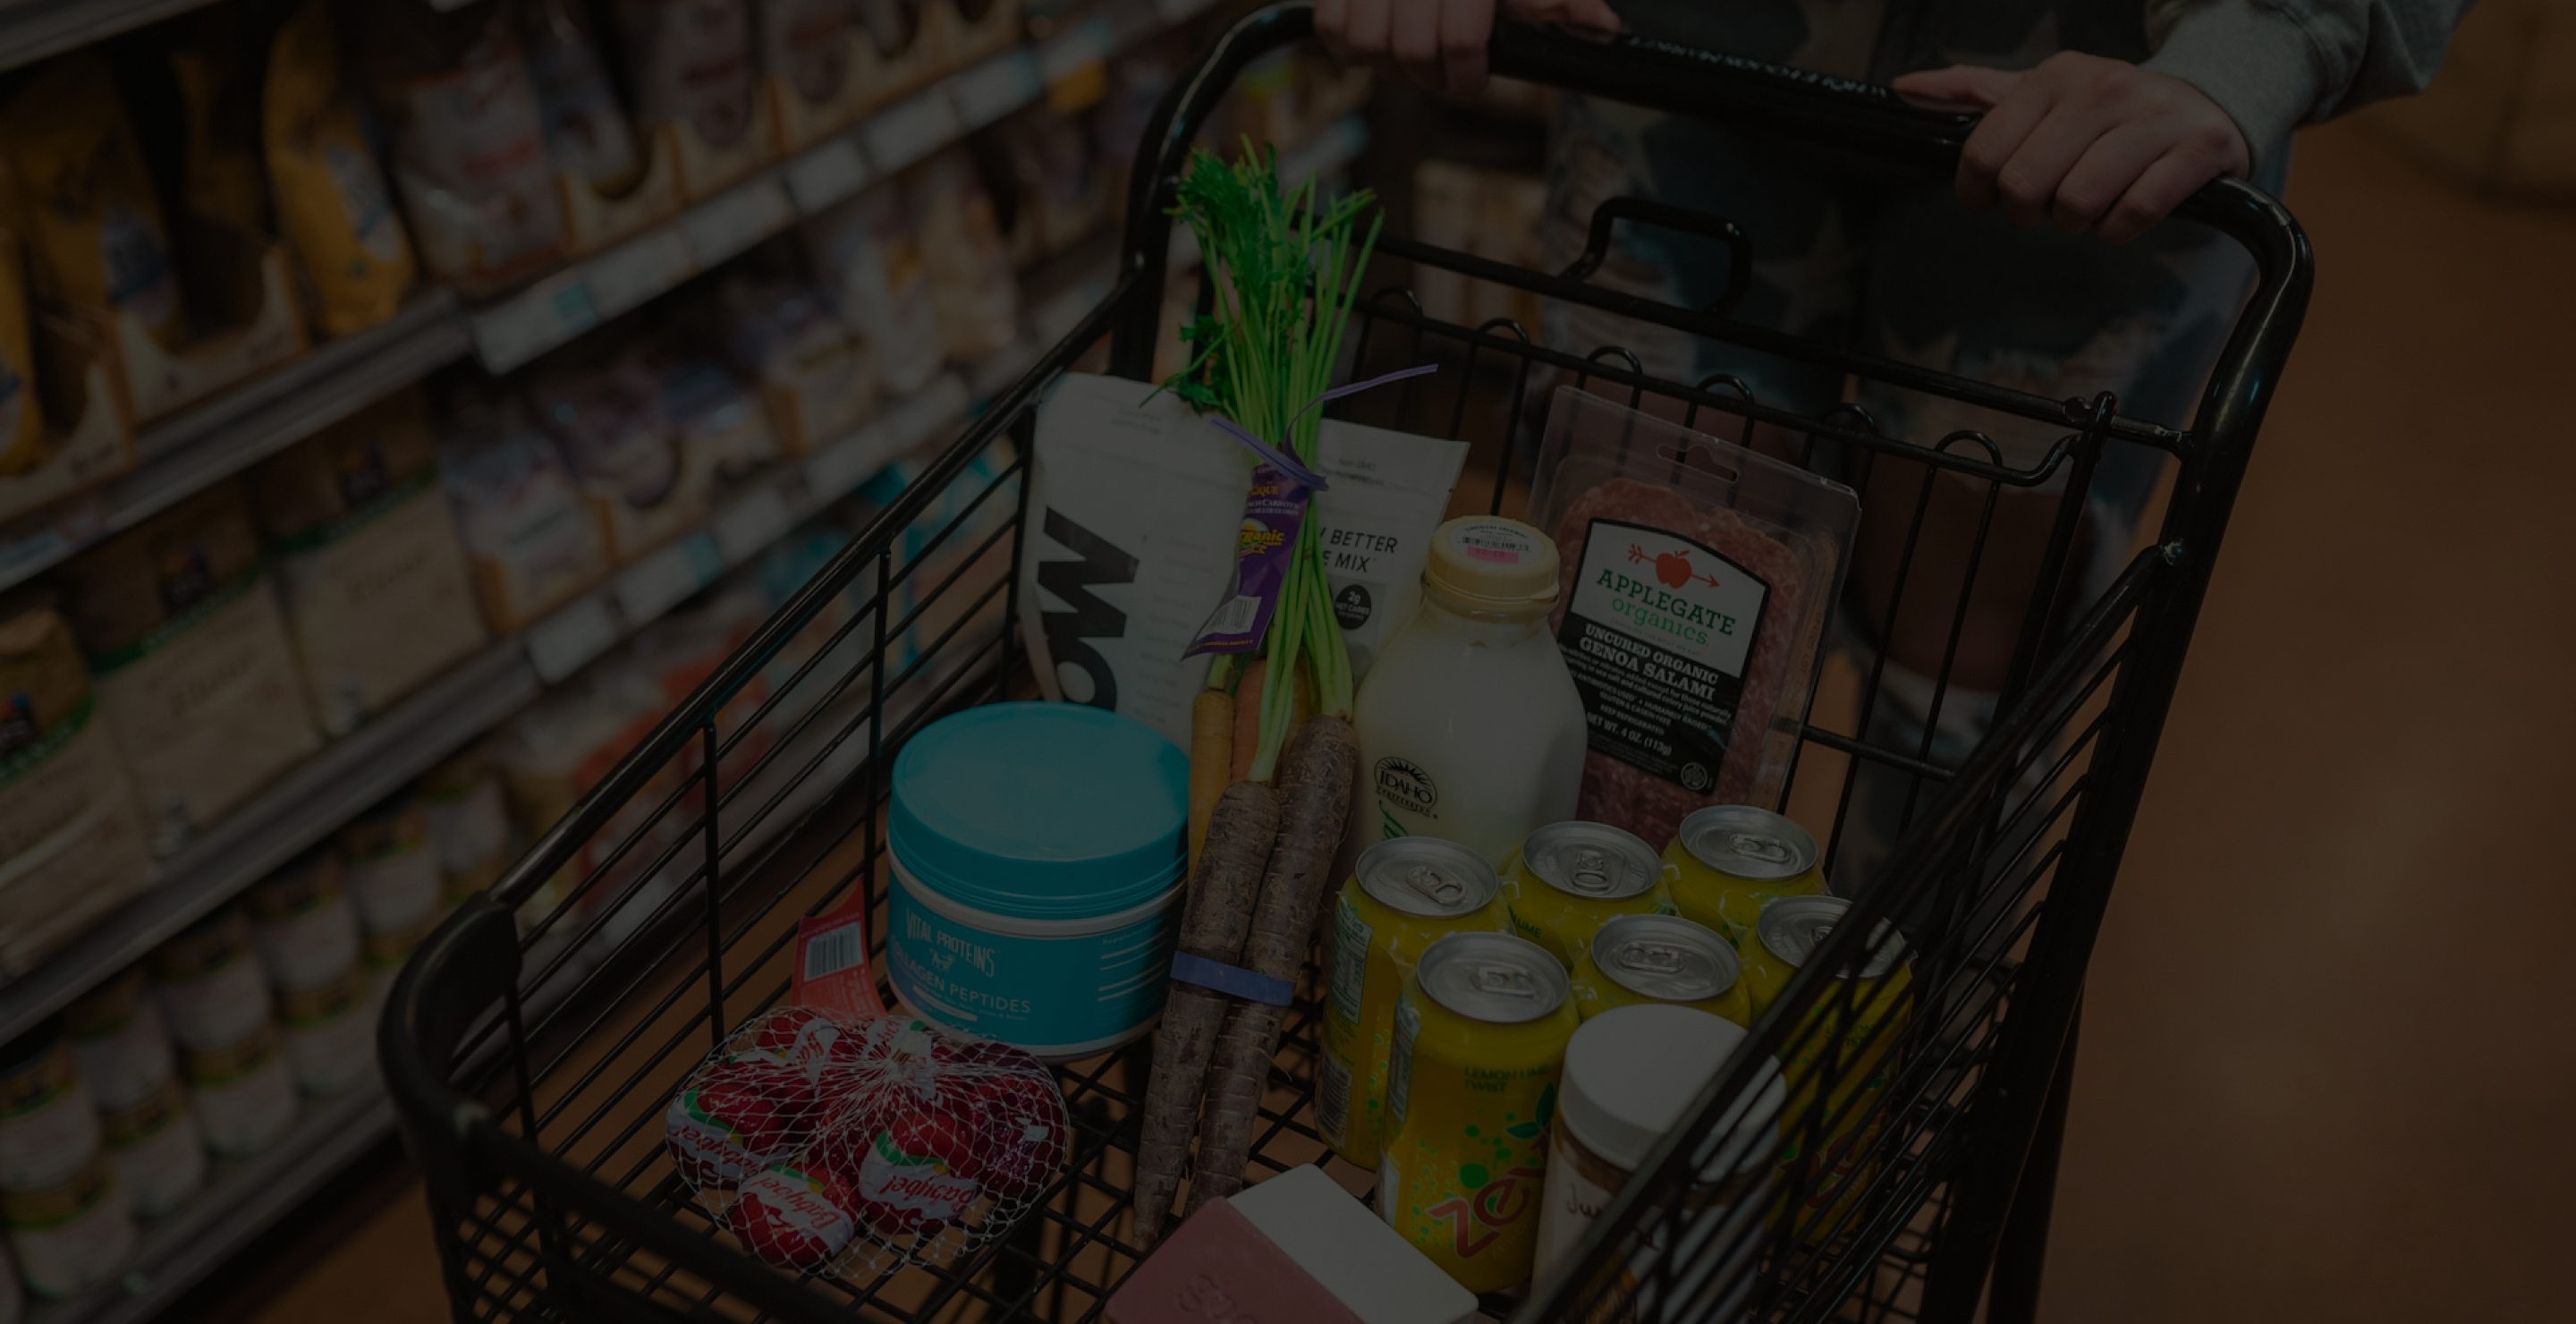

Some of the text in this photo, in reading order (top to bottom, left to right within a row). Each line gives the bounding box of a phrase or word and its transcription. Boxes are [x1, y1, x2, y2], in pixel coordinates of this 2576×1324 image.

[1330, 529, 1399, 555] BETTER
[1335, 553, 1371, 573] MIX
[1347, 590, 1361, 604] 2g
[1596, 567, 1736, 636] APPLEGATE
[1611, 598, 1708, 646] organics
[1579, 636, 1640, 672] GENOA
[1642, 662, 1716, 701] SALAMI
[1585, 623, 1719, 685] UNCURED ORGANIC
[1620, 727, 1629, 737] 4
[1628, 730, 1643, 744] OZ.
[1378, 768, 1433, 805] IDAHO
[905, 907, 933, 943] VITAL
[936, 929, 996, 979] PROTEINS
[948, 982, 1031, 1014] PEPTIDES
[1464, 1065, 1518, 1081] LEMON
[1465, 1080, 1508, 1092] TWIST
